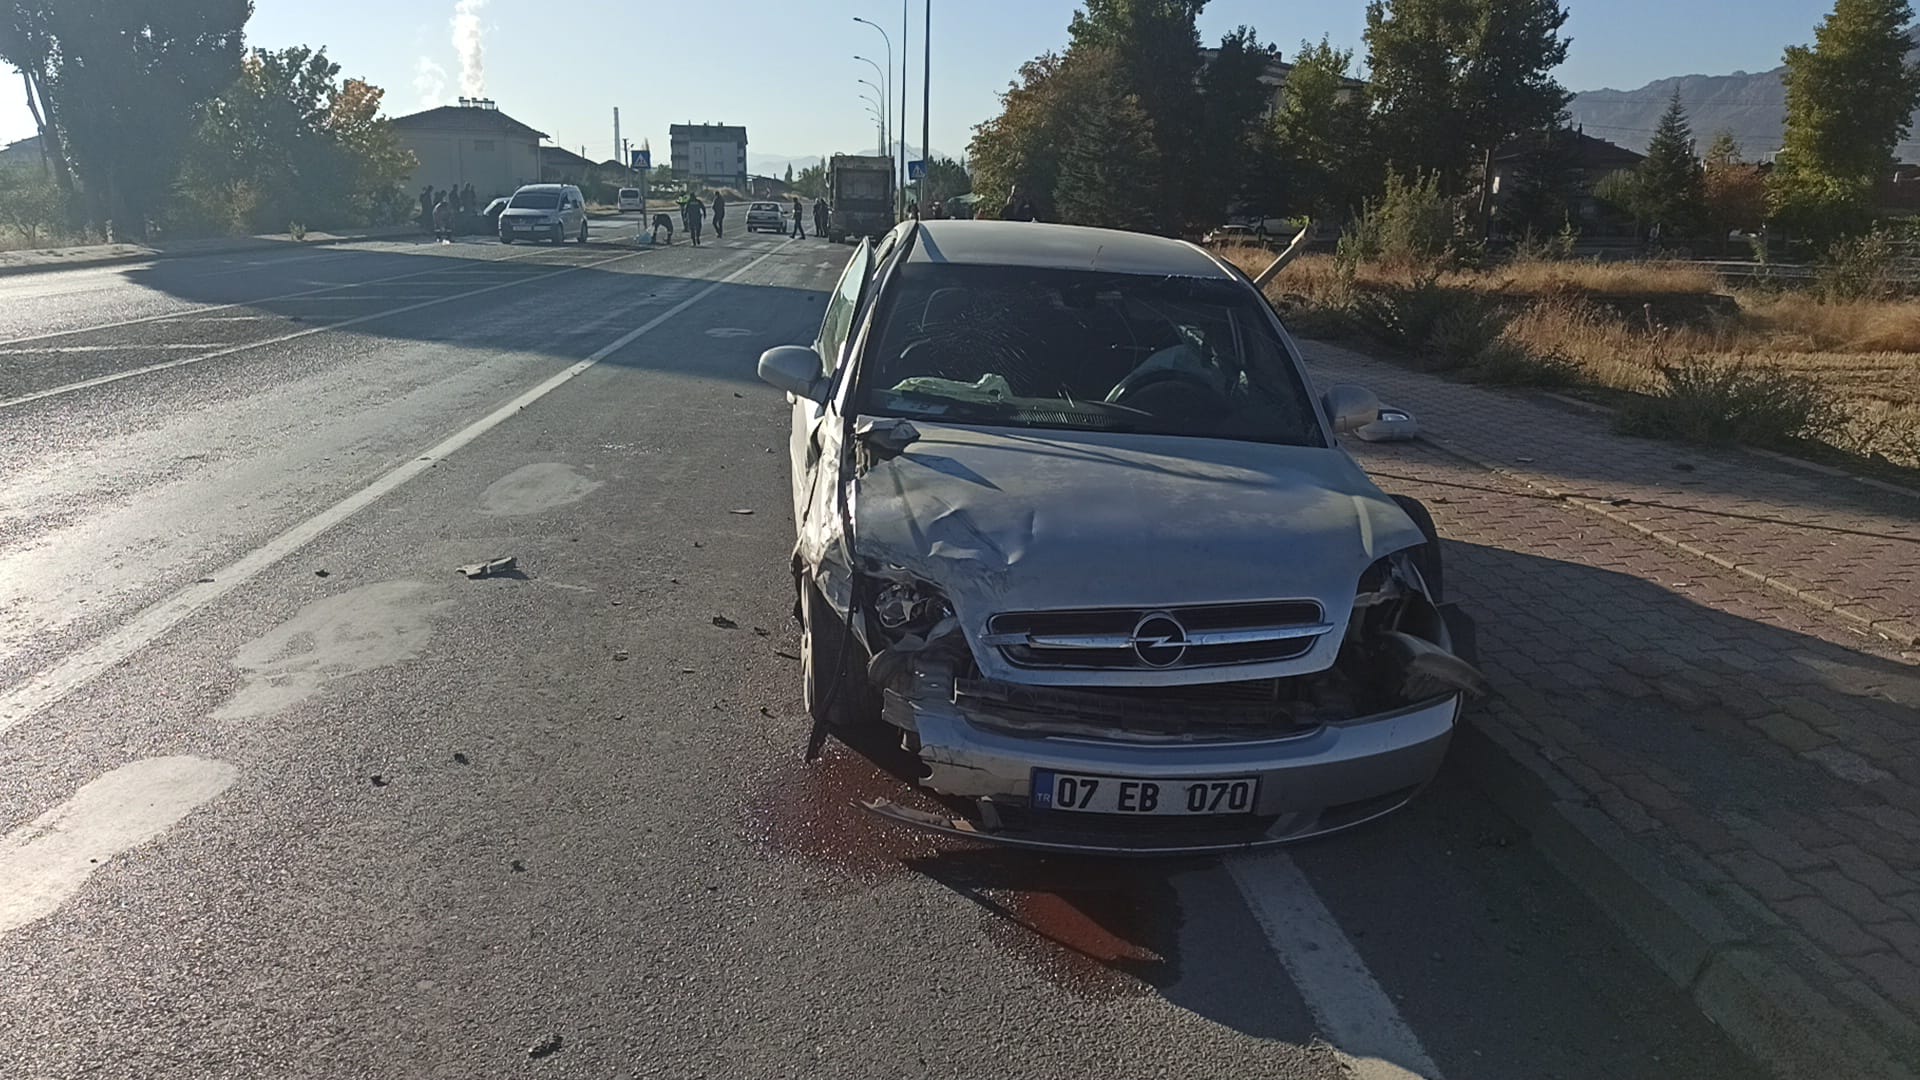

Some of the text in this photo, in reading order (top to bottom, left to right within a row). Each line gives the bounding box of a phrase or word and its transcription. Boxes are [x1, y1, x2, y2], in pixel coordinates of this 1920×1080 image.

[1036, 792, 1051, 802] TR
[1057, 777, 1249, 812] 07 EB 070
